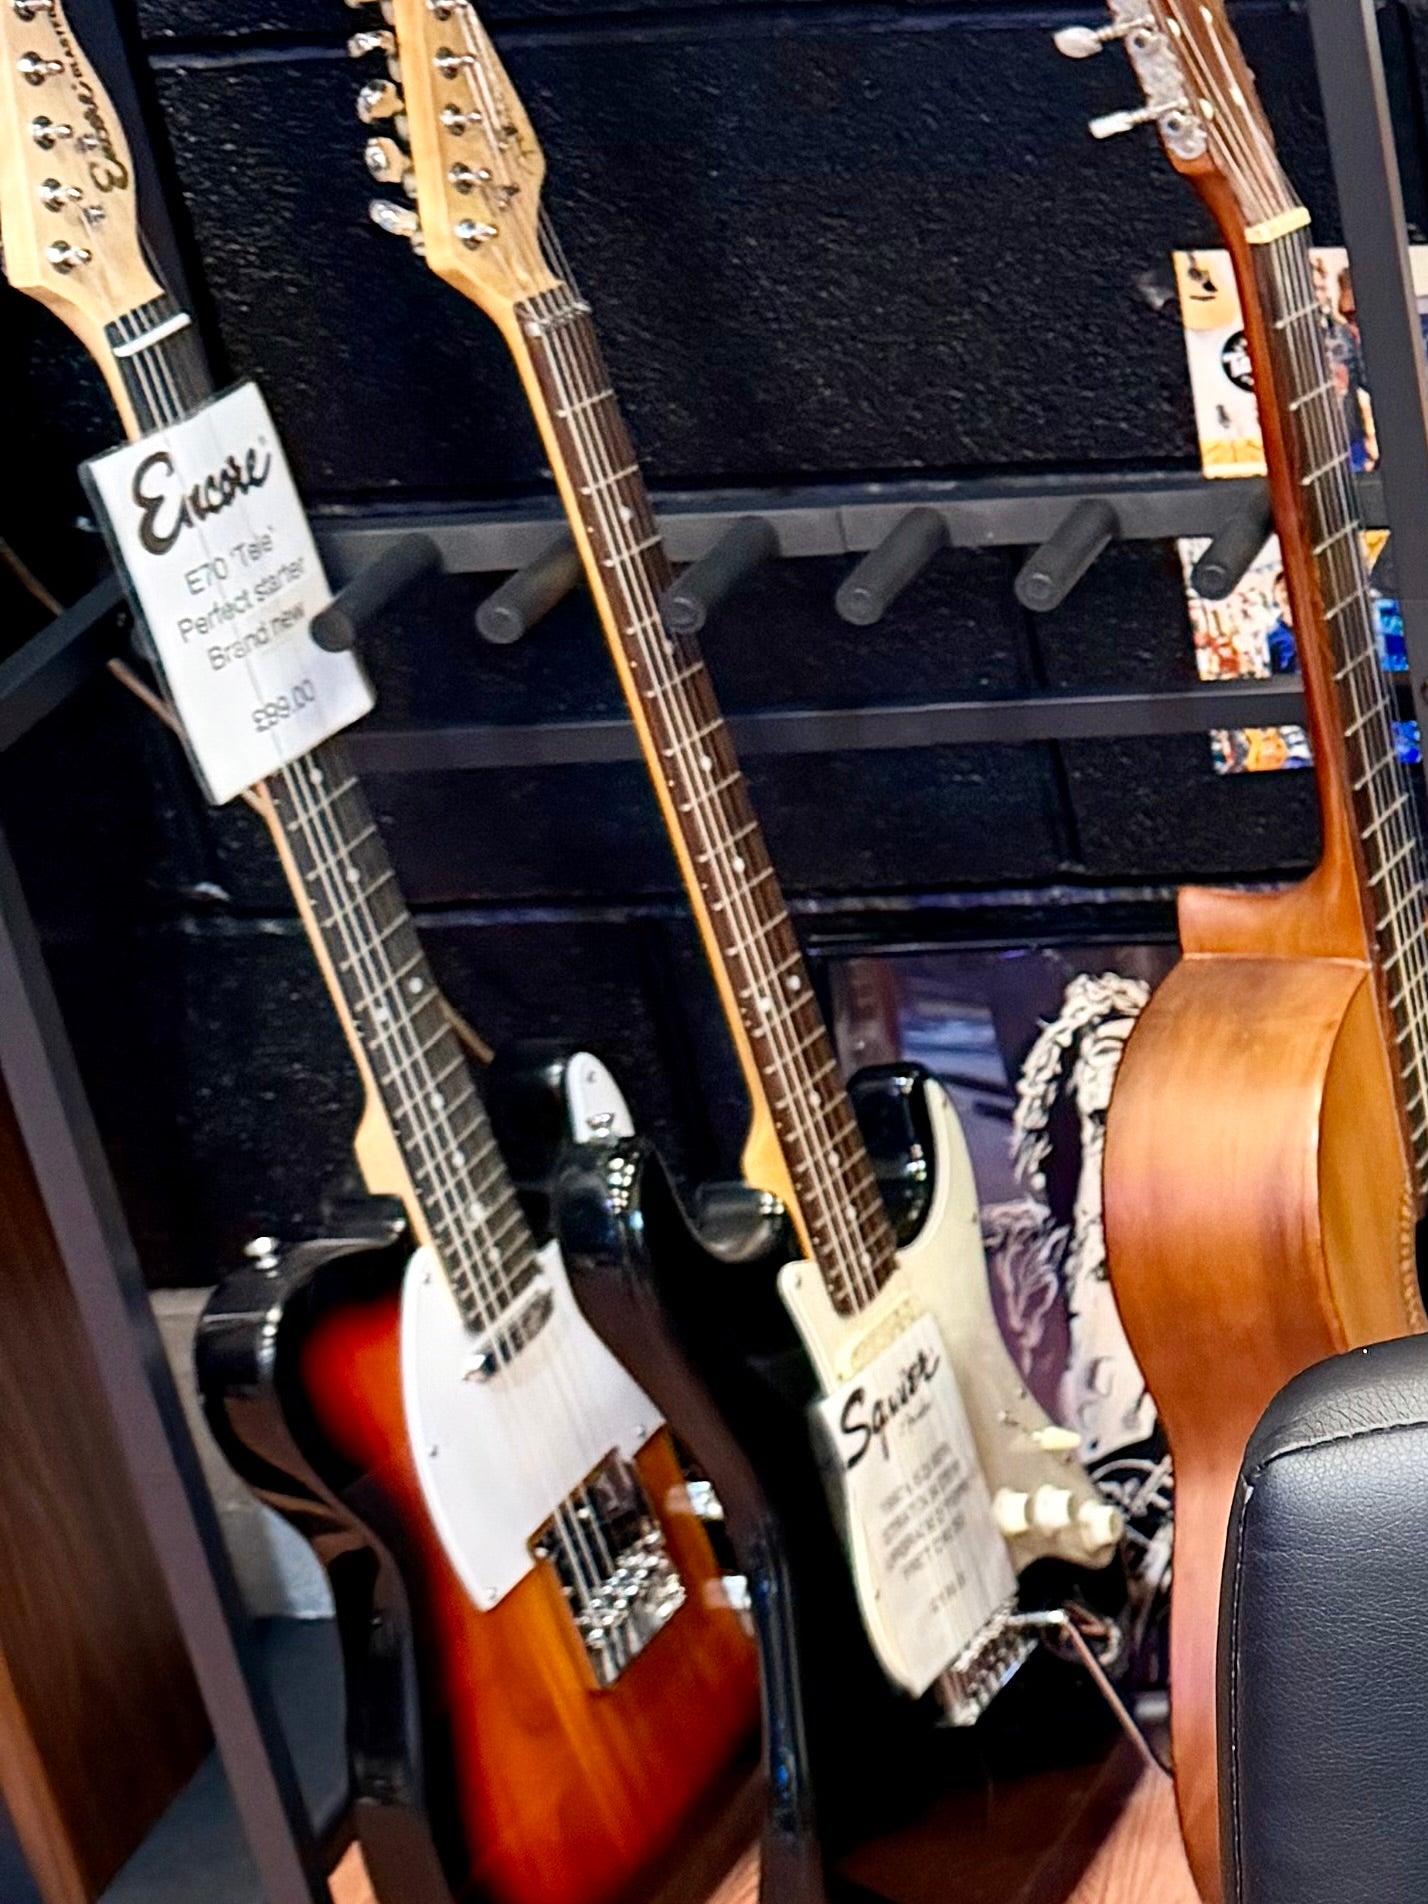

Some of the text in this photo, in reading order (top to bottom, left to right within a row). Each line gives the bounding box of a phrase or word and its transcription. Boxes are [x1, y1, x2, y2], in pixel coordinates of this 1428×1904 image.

[132, 447, 272, 556] Encore
[177, 557, 306, 644] Perfect starter
[184, 556, 228, 596] E70
[207, 601, 306, 671] Brand new
[841, 1348, 940, 1470] Squier
